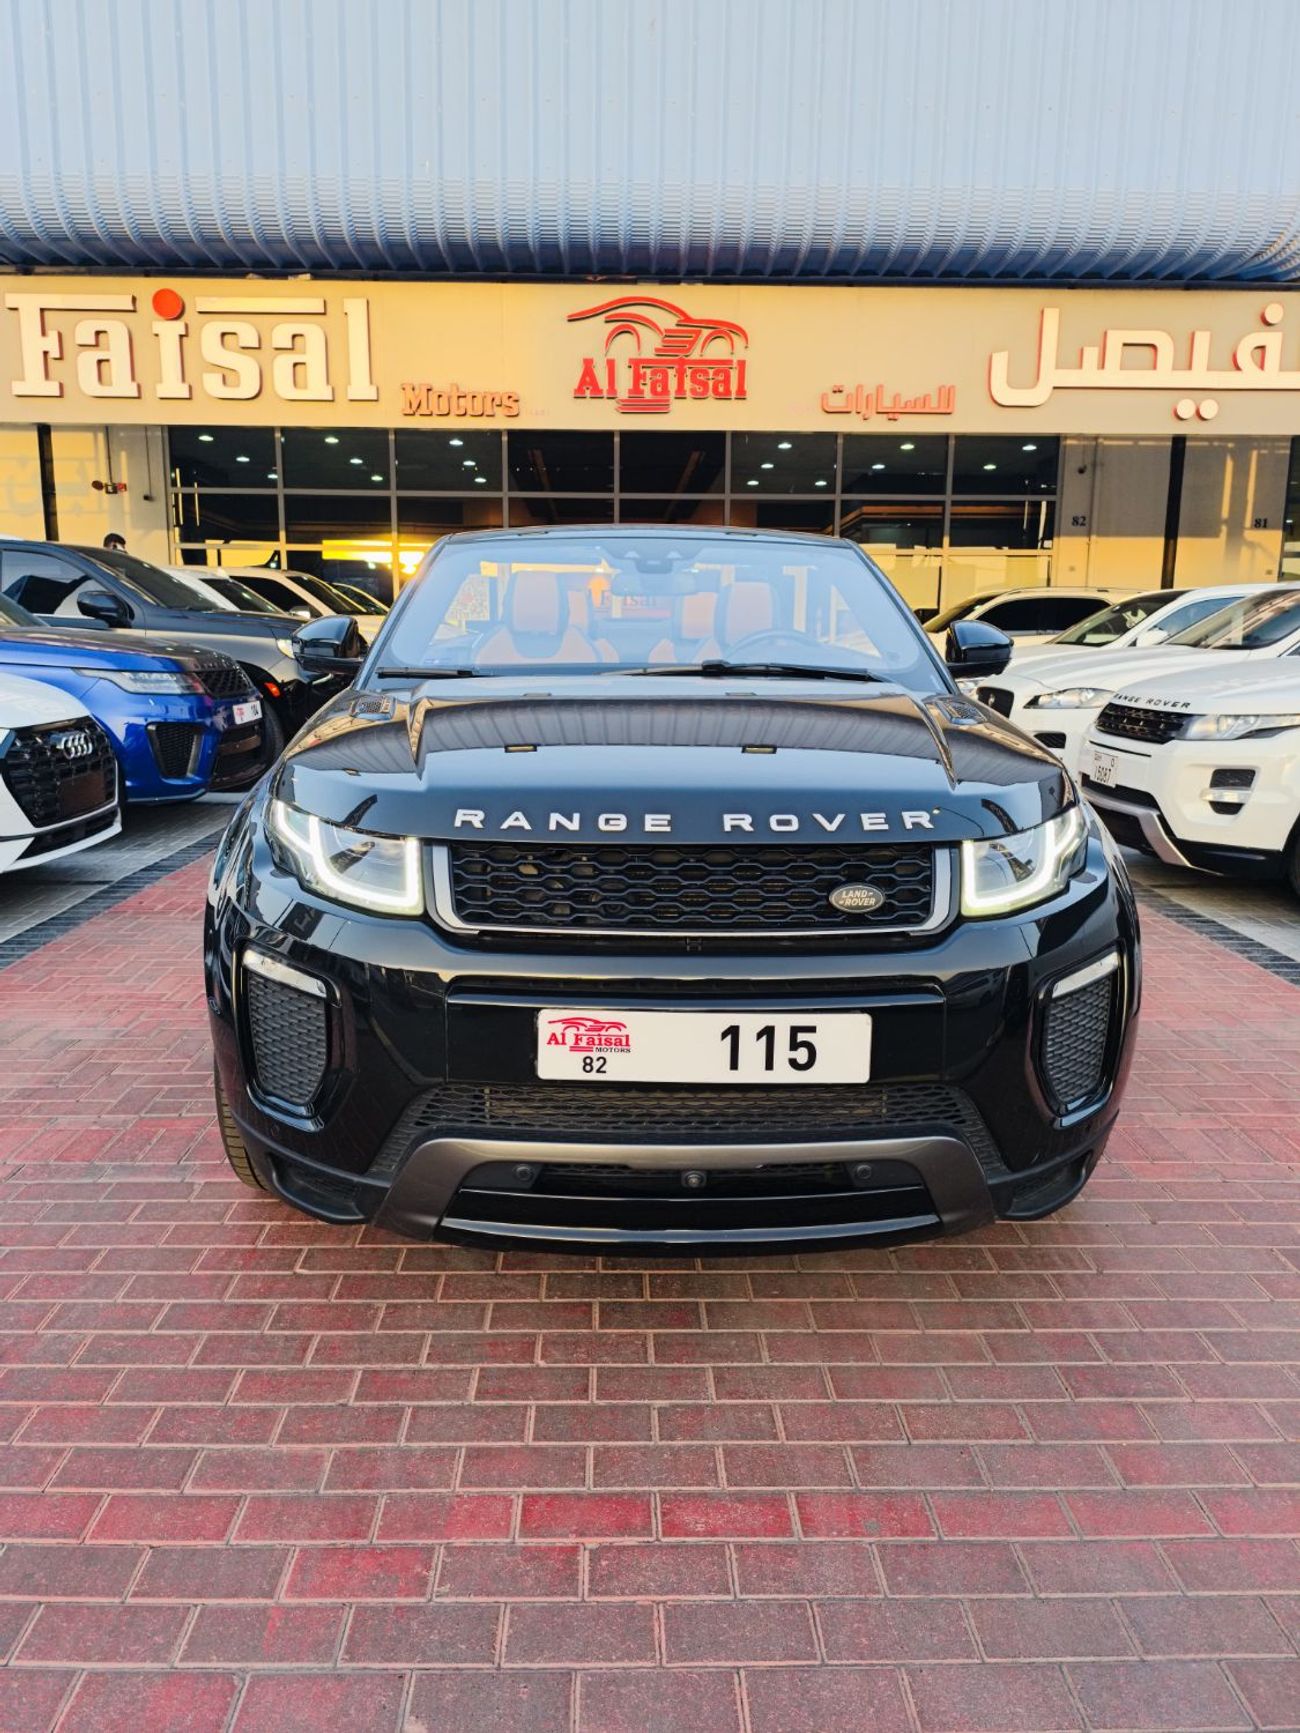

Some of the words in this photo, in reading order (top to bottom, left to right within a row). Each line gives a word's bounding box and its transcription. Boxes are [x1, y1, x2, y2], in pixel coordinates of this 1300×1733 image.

[5, 288, 379, 401] Faisal
[989, 302, 1300, 422] فيصل
[573, 357, 619, 399] Al
[627, 357, 748, 401] Faisal
[401, 383, 520, 418] Motors
[820, 383, 956, 422] للسيارات
[1071, 515, 1087, 527] 82
[1254, 518, 1269, 529] 81
[1146, 699, 1191, 709] ROVER
[453, 808, 672, 833] RANGE
[722, 810, 935, 832] ROVER
[546, 1032, 567, 1046] Al
[573, 1032, 631, 1048] Faisal
[720, 1024, 818, 1072] 115
[582, 1055, 607, 1074] 82
